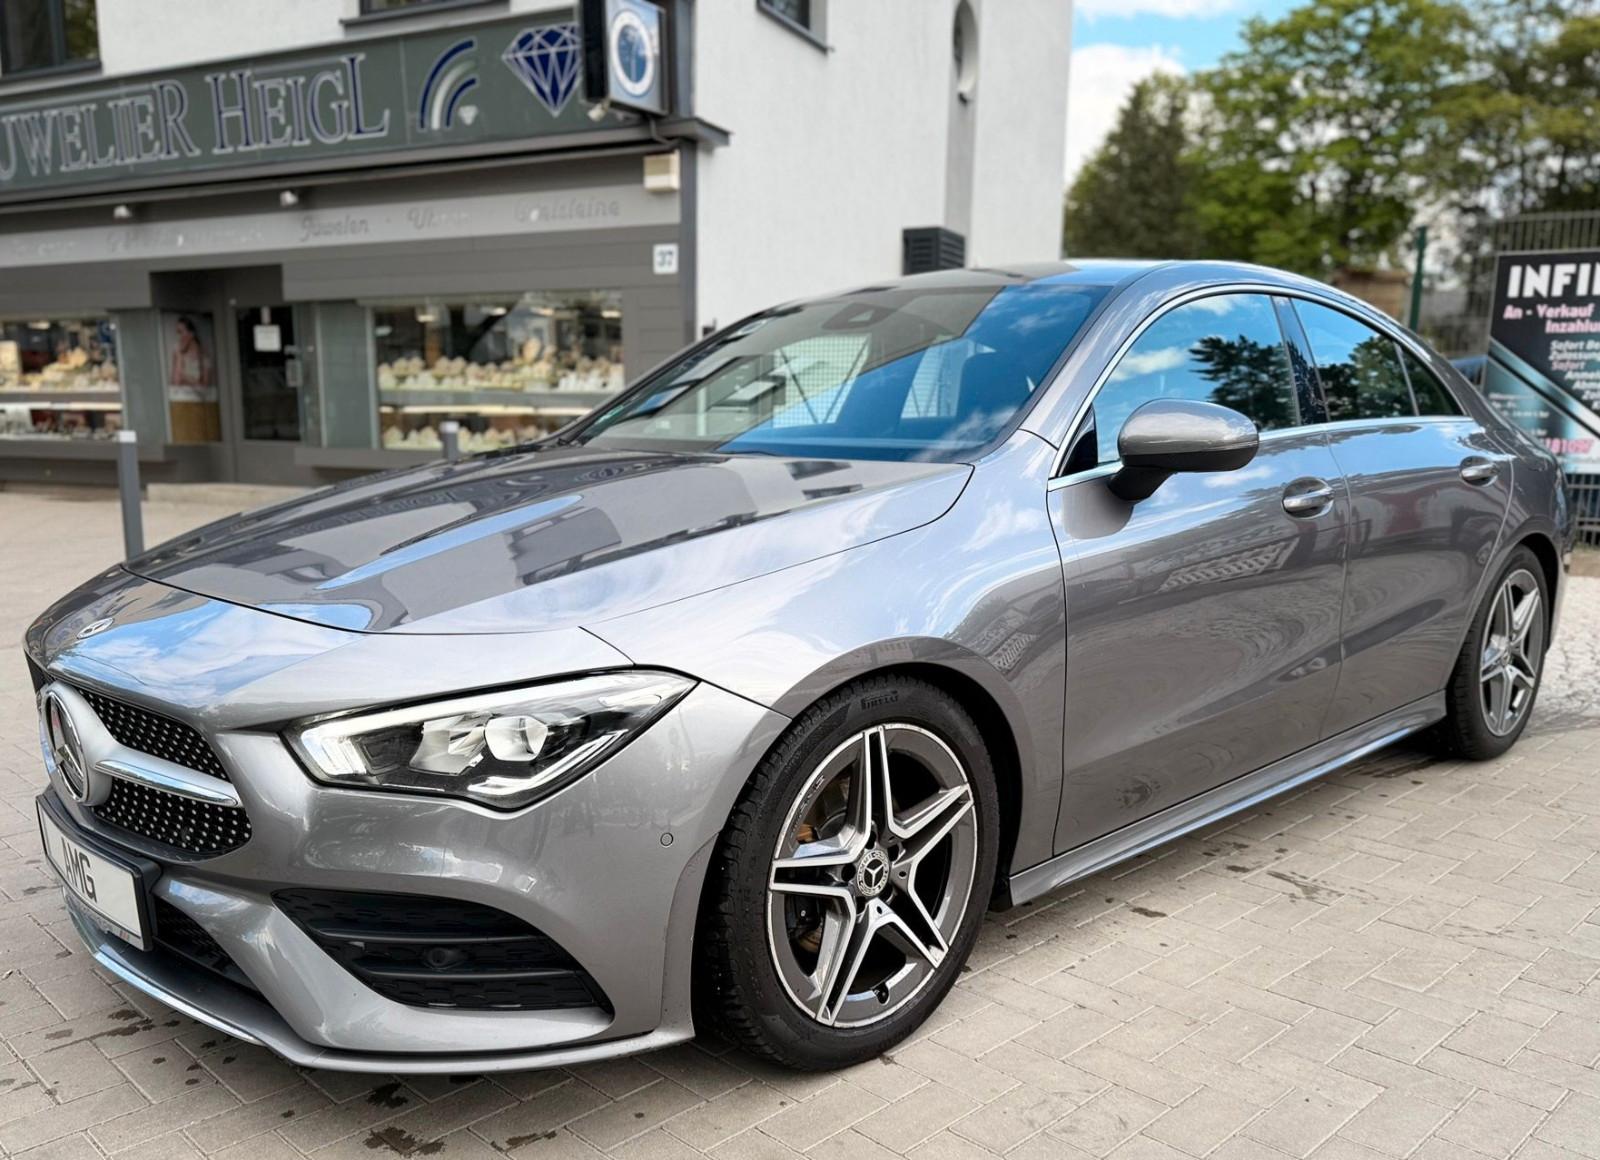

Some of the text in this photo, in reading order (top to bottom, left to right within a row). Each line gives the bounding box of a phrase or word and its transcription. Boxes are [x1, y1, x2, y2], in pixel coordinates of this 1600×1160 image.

[205, 52, 390, 155] HEIGL
[656, 250, 674, 267] 37
[1503, 304, 1523, 320] An
[1536, 302, 1595, 319] Verkauf
[61, 836, 97, 903] AMG
